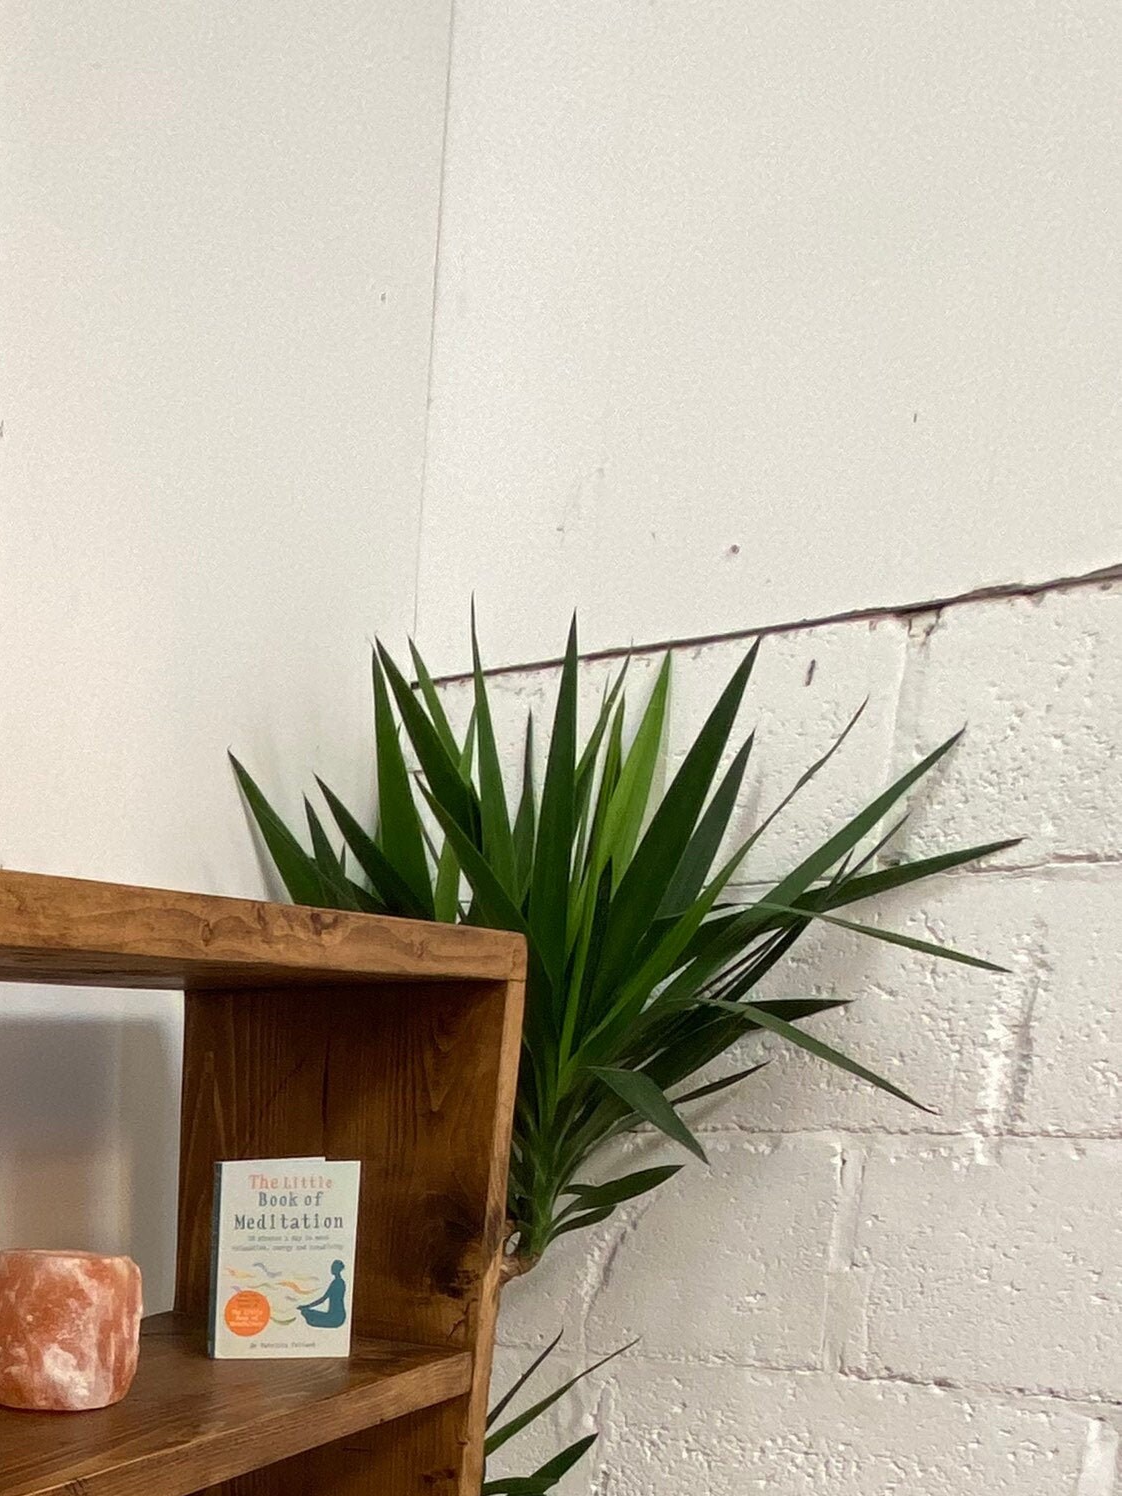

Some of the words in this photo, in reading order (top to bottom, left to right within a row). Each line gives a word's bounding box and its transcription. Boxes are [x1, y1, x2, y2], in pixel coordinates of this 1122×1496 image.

[248, 1174, 278, 1189] The
[283, 1175, 333, 1189] Little
[258, 1191, 298, 1207] Book
[304, 1191, 324, 1206] of
[234, 1213, 344, 1230] Meditation
